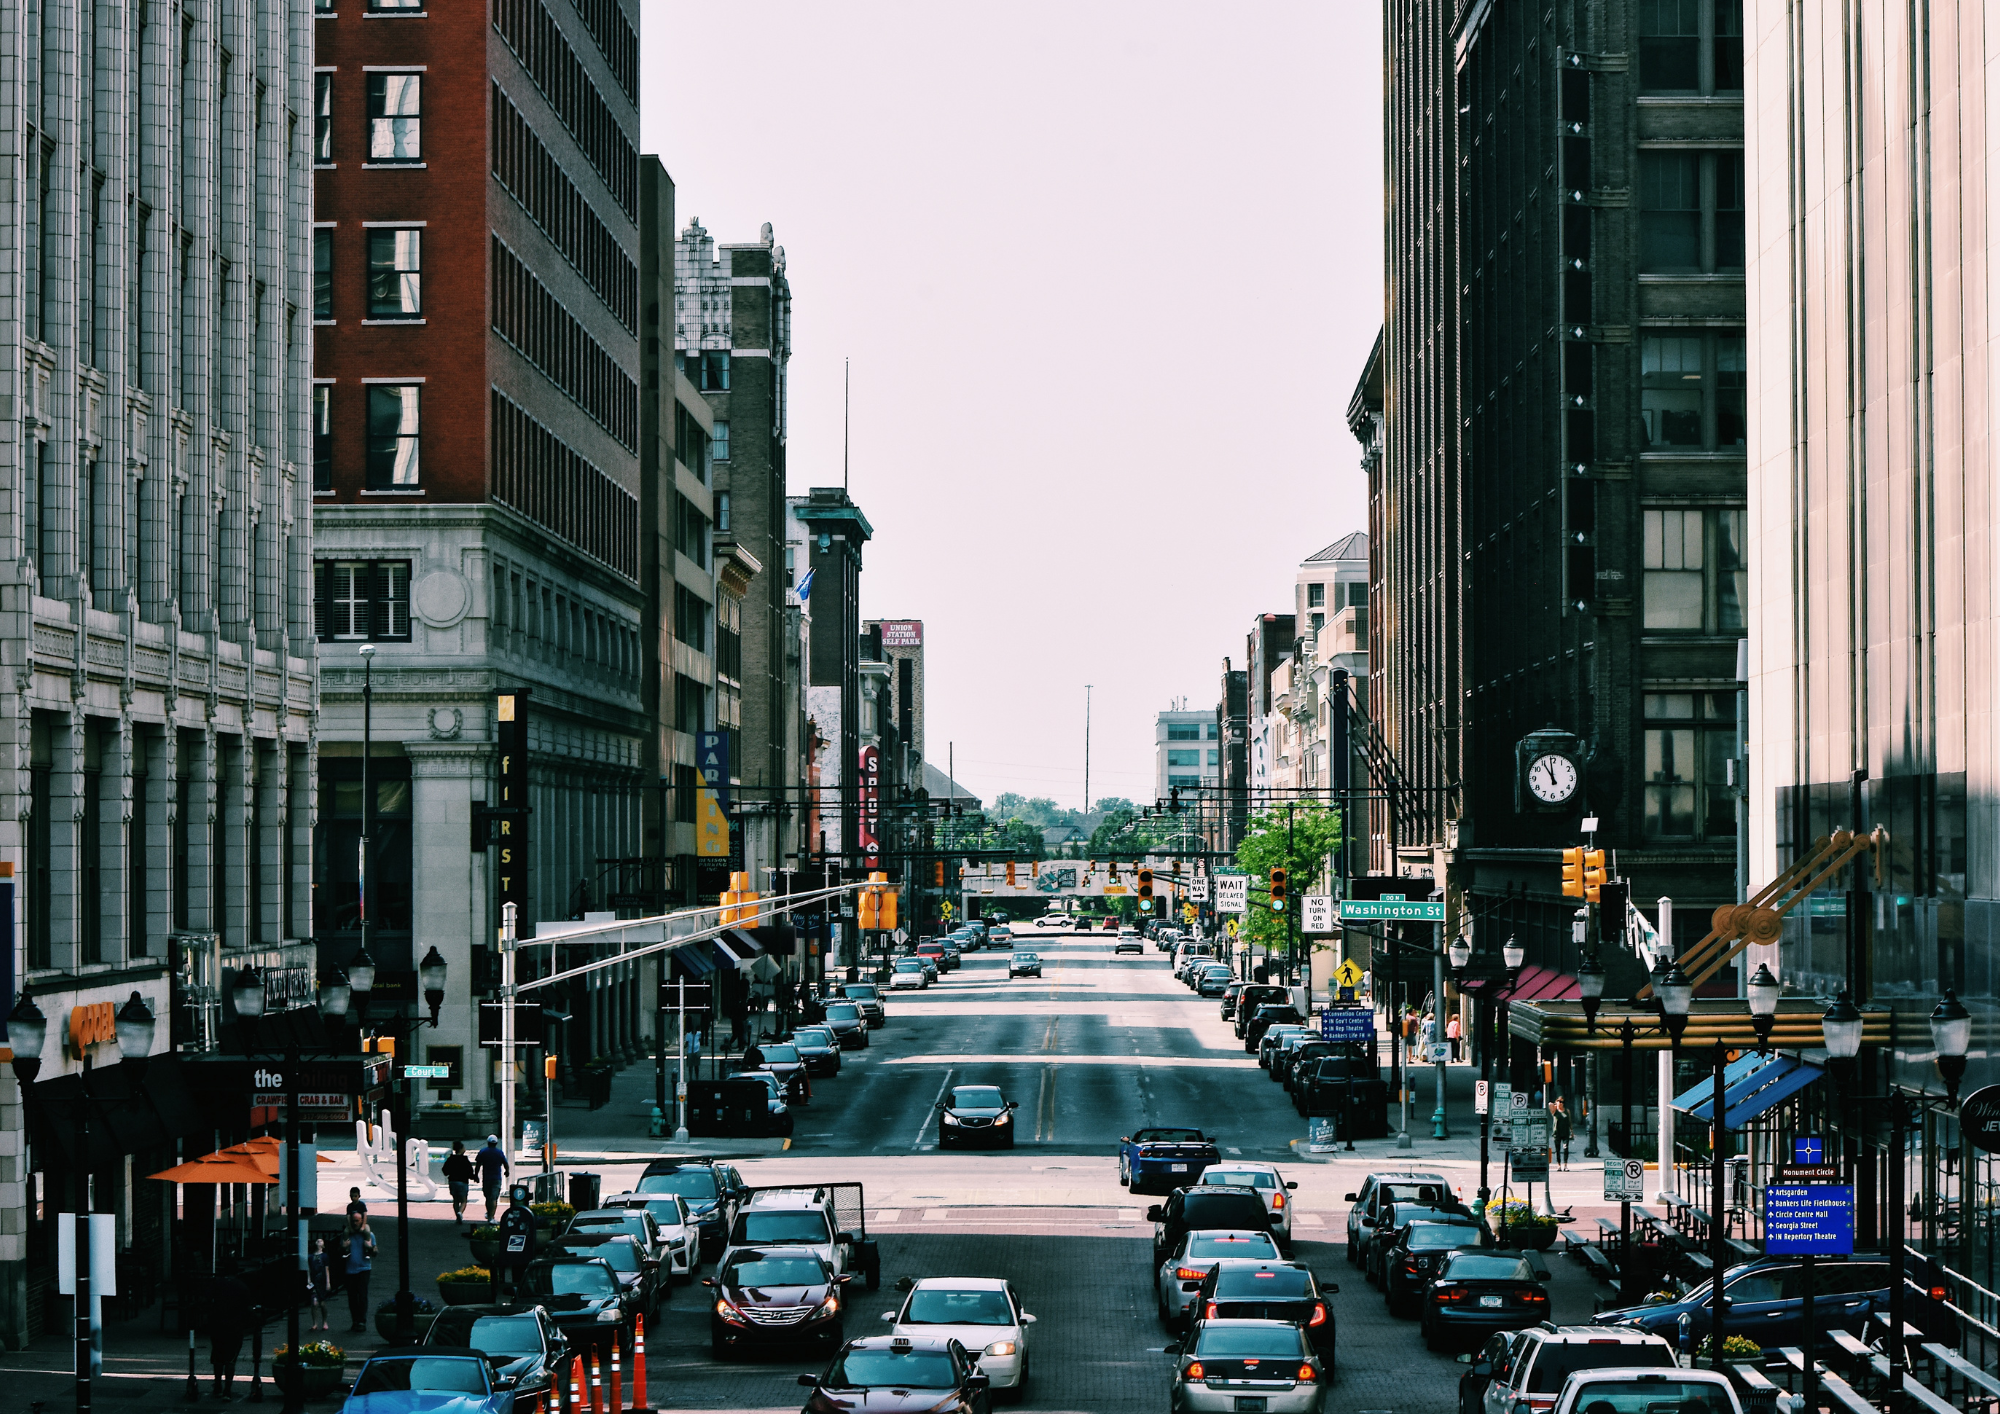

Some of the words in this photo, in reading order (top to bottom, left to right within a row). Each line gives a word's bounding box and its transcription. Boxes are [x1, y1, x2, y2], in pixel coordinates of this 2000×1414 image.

[704, 735, 721, 853] PARKING
[868, 757, 878, 834] SPOT
[1220, 880, 1244, 890] WAIT
[1345, 905, 1421, 918] Washington
[1426, 906, 1440, 916] St
[412, 1066, 436, 1076] Court
[254, 1068, 282, 1088] the
[256, 1096, 288, 1105] CRAWFIS
[300, 1096, 321, 1104] CRAB
[322, 1096, 328, 1104] &
[328, 1095, 344, 1104] BAR
[1981, 1120, 2000, 1132] JE
[1776, 1189, 1808, 1197] Artsgarden
[1776, 1222, 1798, 1230] Georgia
[1784, 1233, 1812, 1241] Repertory
